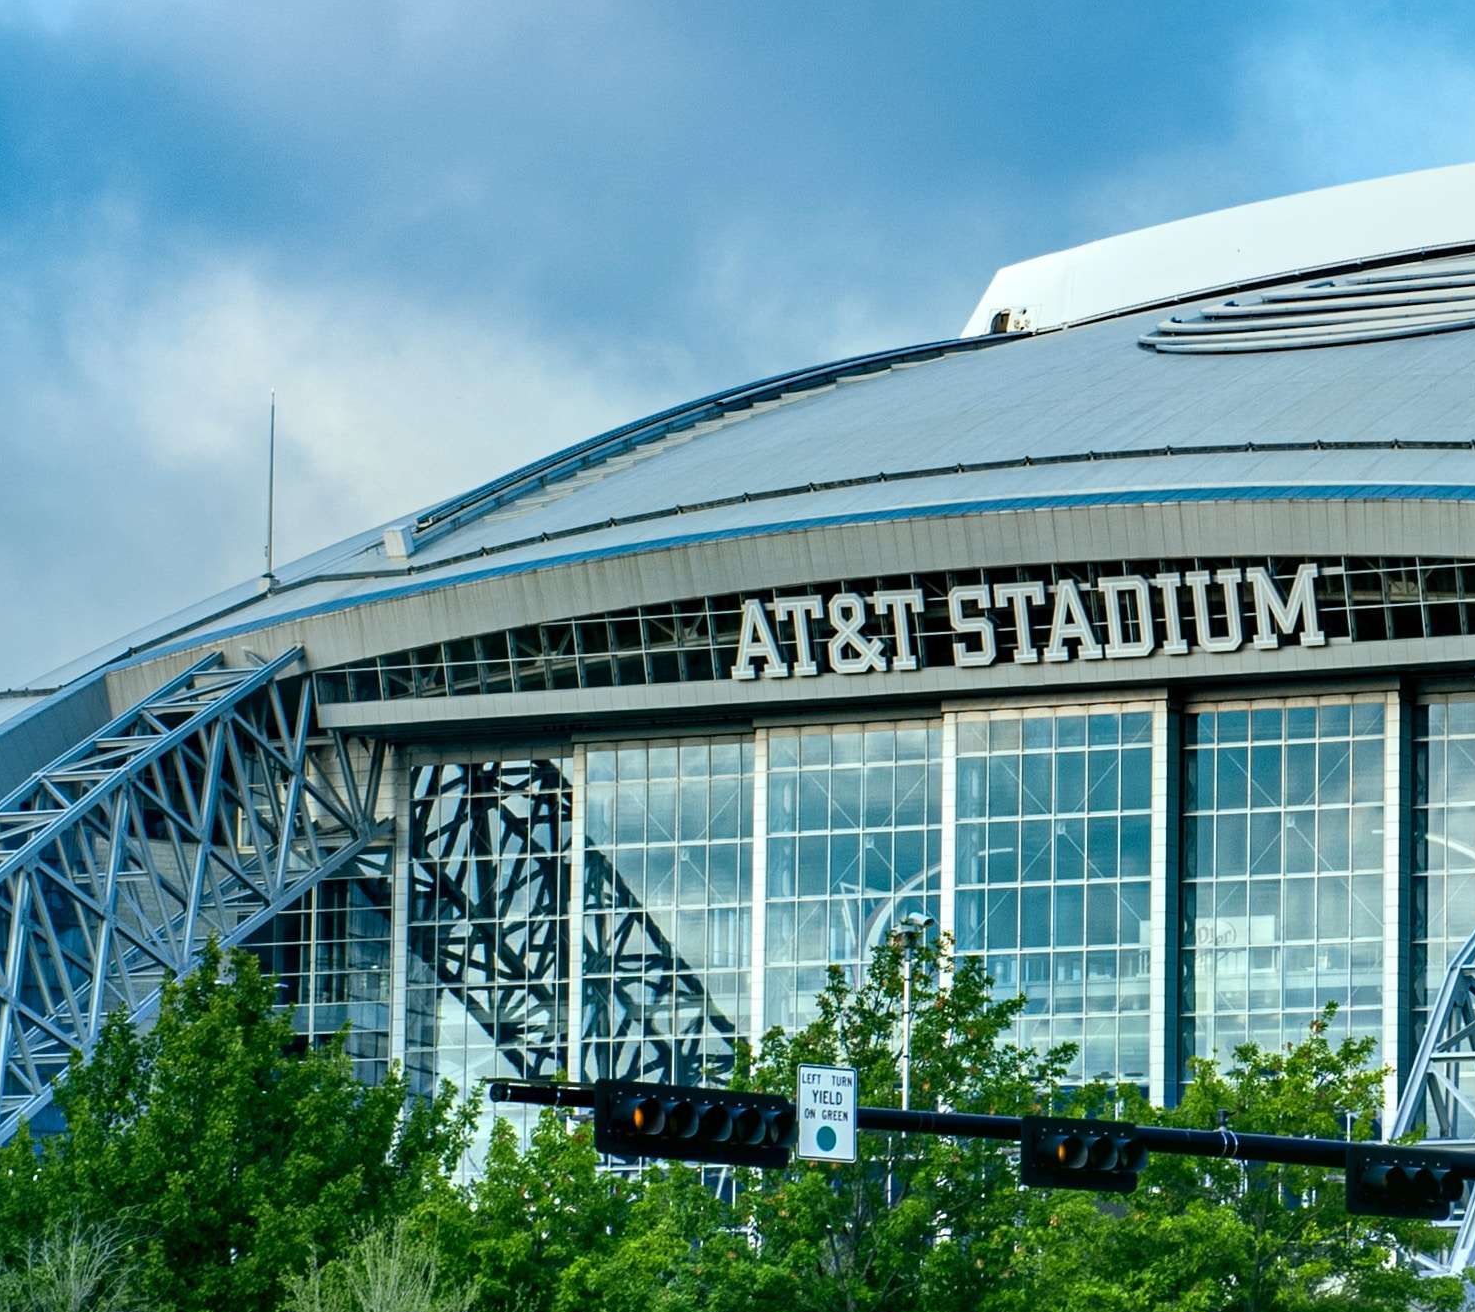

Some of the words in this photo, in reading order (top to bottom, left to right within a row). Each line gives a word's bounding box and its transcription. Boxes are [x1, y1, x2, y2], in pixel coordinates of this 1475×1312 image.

[731, 589, 924, 680] AT&T
[947, 563, 1326, 667] STADIUM
[802, 1074, 821, 1084] LEFT
[832, 1076, 852, 1087] TURN
[813, 1090, 842, 1105] YIELD
[805, 1109, 815, 1119] ON
[822, 1110, 848, 1121] GREEN
